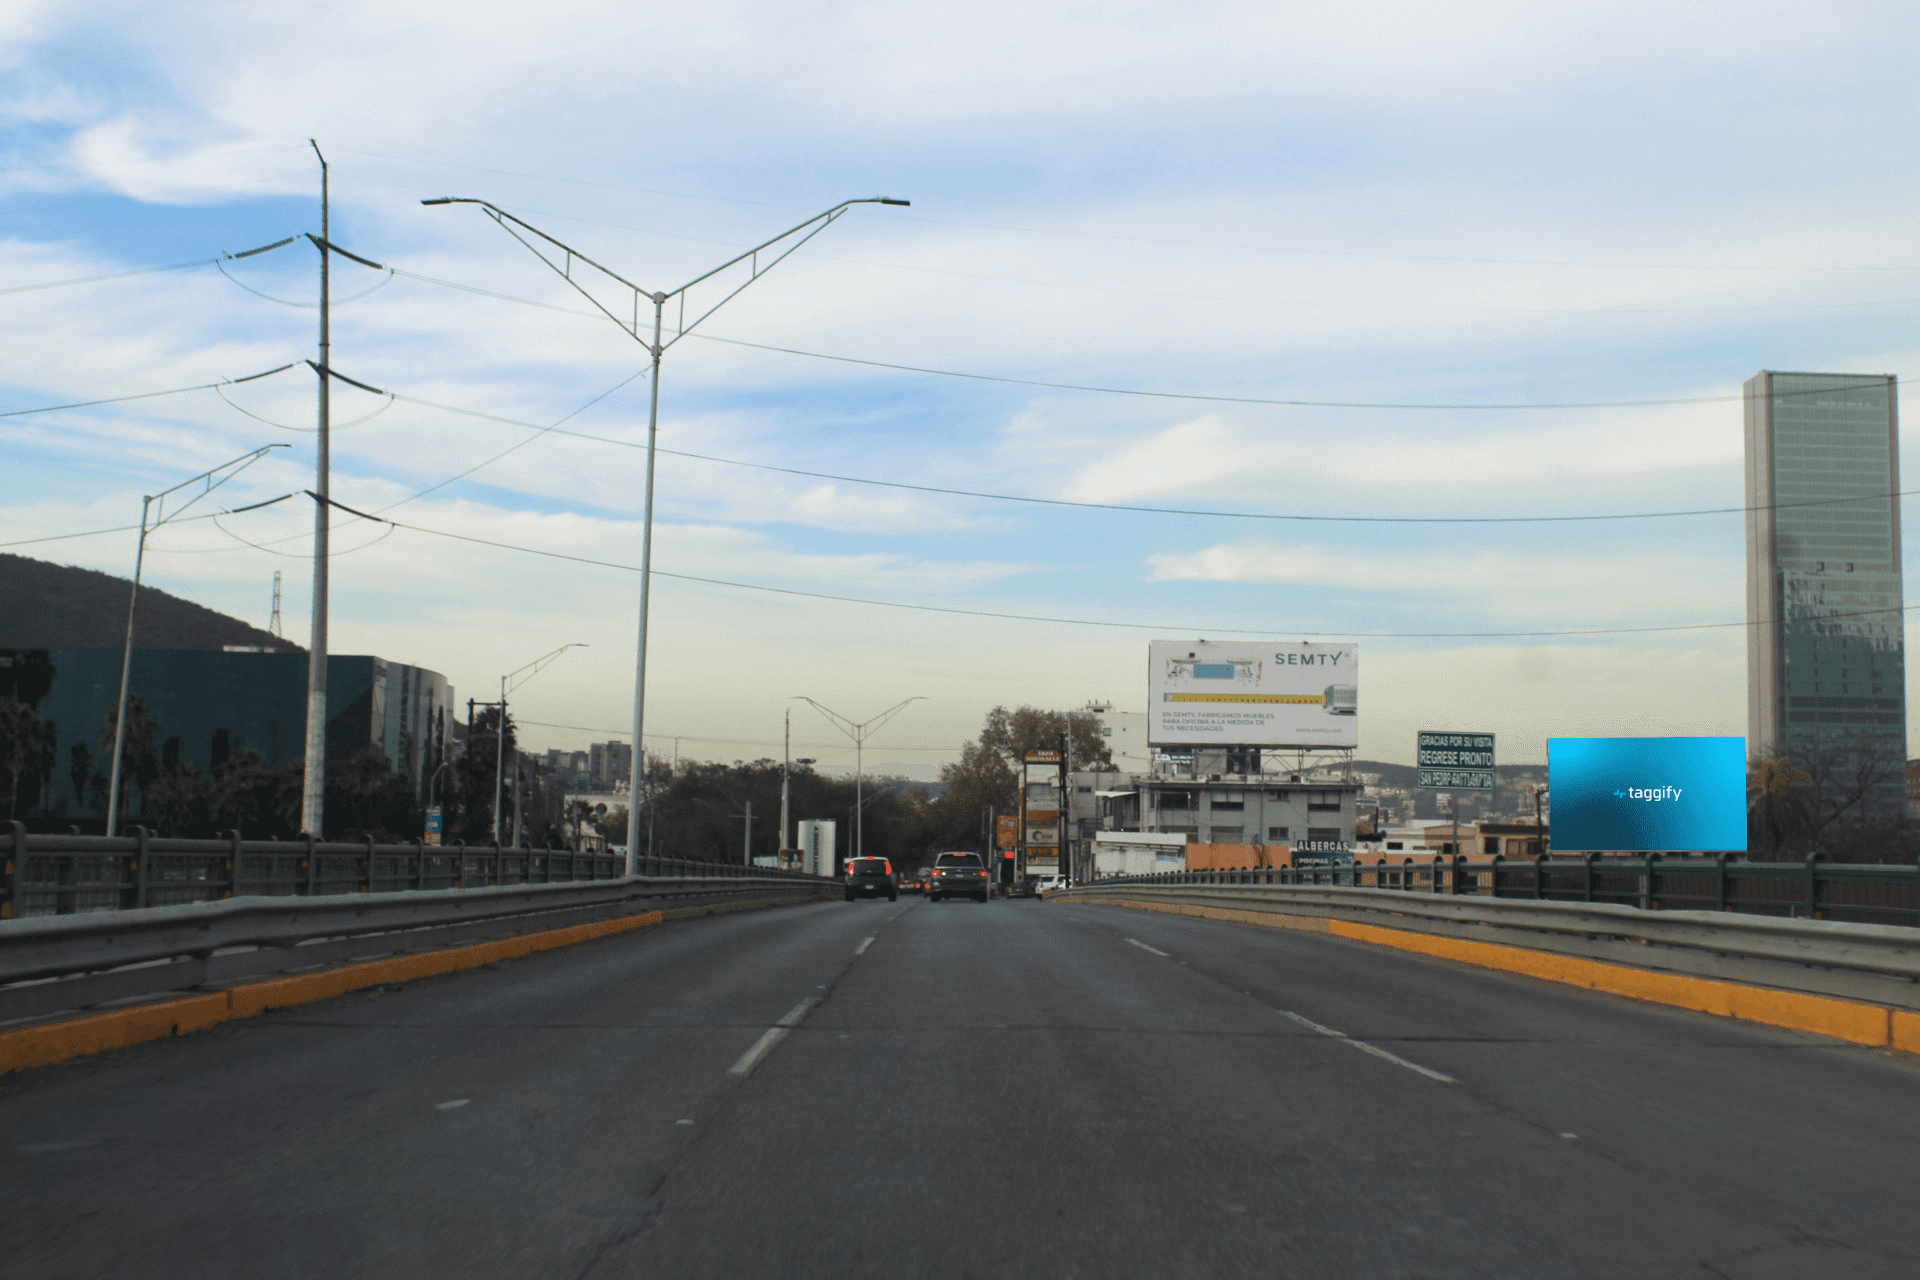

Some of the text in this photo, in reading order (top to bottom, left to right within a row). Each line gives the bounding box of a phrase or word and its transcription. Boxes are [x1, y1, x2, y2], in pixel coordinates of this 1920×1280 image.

[1275, 651, 1342, 666] SEMTY
[1421, 735, 1492, 747] GRACIAS POR SU VISITA
[1421, 750, 1492, 766] REGRESE PRONTO
[1628, 786, 1682, 801] taggify
[1298, 841, 1349, 852] ALBERCAS
